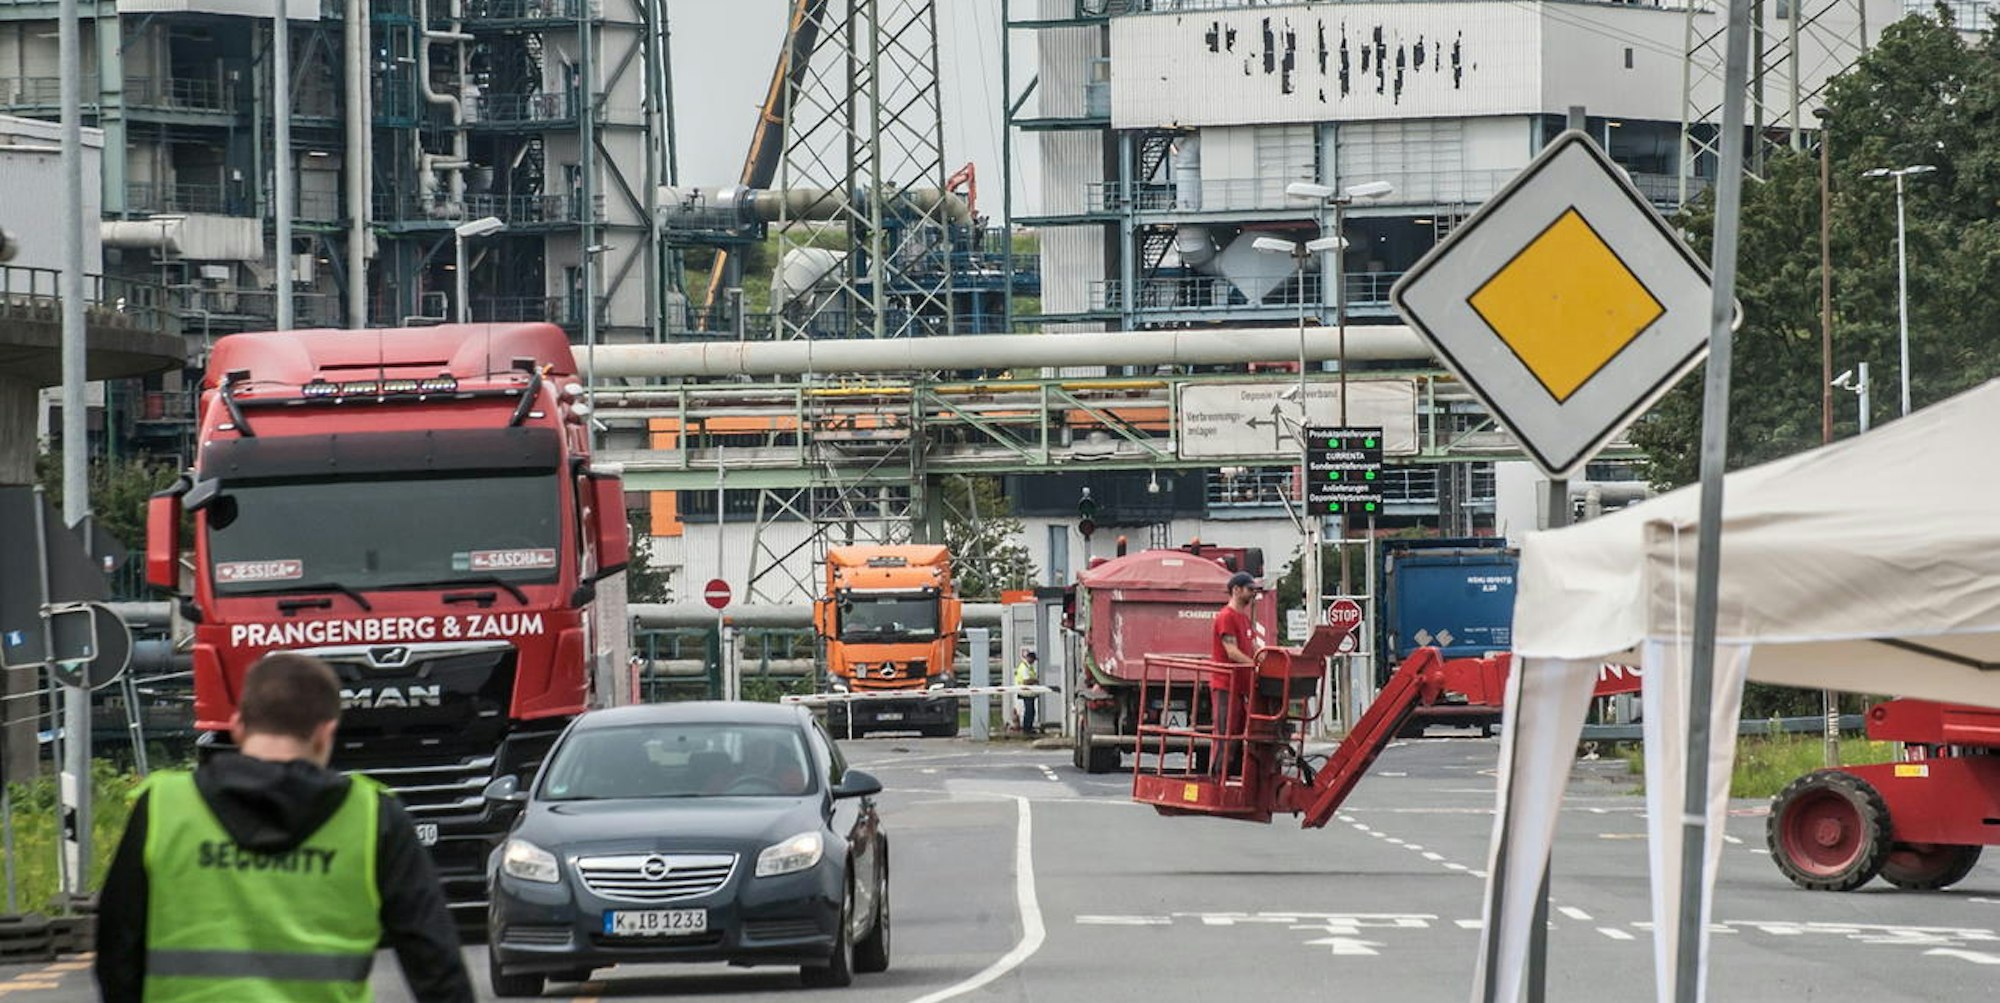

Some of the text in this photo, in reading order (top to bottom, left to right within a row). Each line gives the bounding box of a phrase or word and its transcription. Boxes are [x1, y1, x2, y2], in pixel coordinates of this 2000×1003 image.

[488, 551, 537, 567] SASCHA
[231, 563, 287, 579] JESSICA
[1331, 609, 1359, 622] STOP
[231, 613, 544, 647] PRANGENBERG & ZAUM
[339, 684, 440, 709] MAN
[616, 912, 704, 929] K IB 1233
